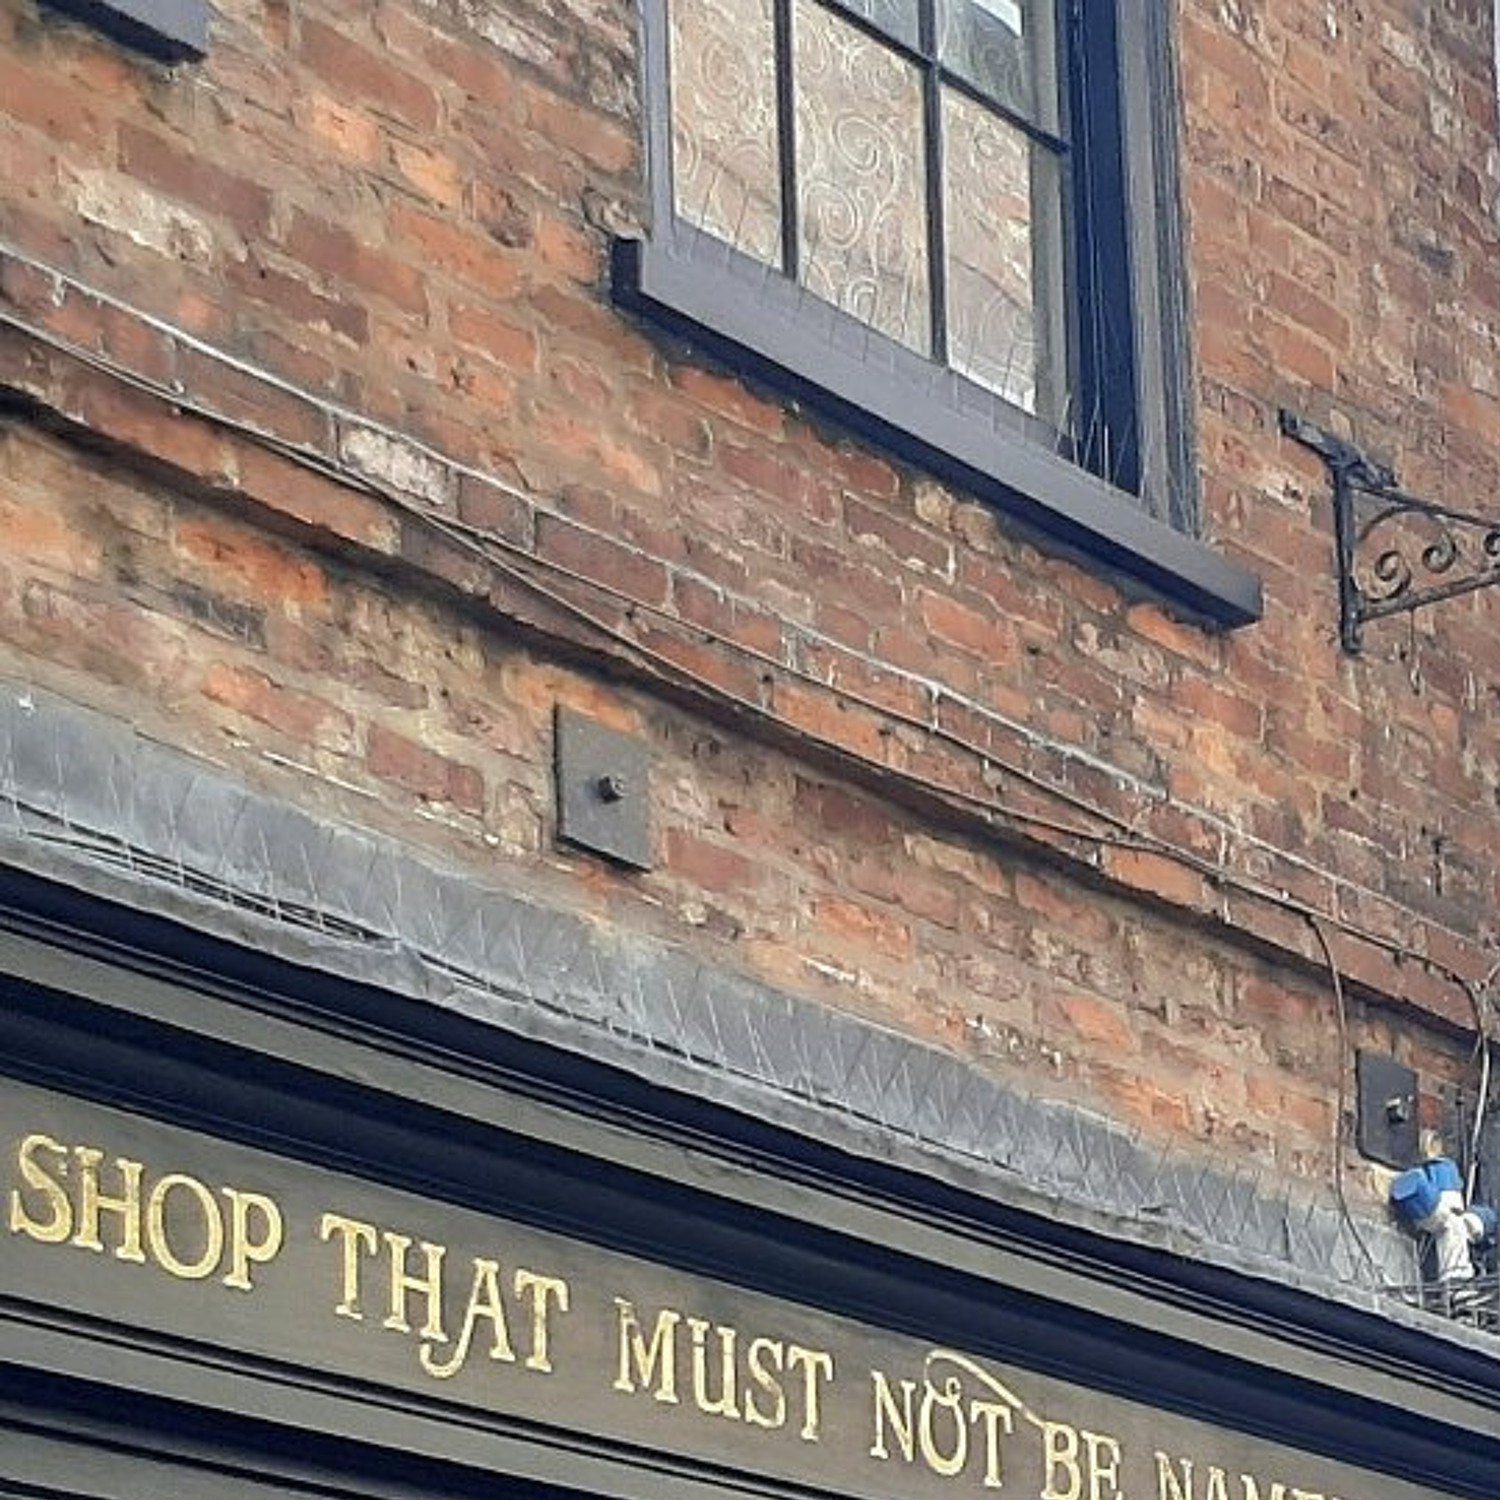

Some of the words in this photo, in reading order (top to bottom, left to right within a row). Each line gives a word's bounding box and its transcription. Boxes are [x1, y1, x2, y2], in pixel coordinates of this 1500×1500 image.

[9, 1132, 285, 1292] SHOP
[319, 1211, 571, 1379] THAT
[611, 1294, 835, 1443] MUST
[869, 1348, 1030, 1489] NOT
